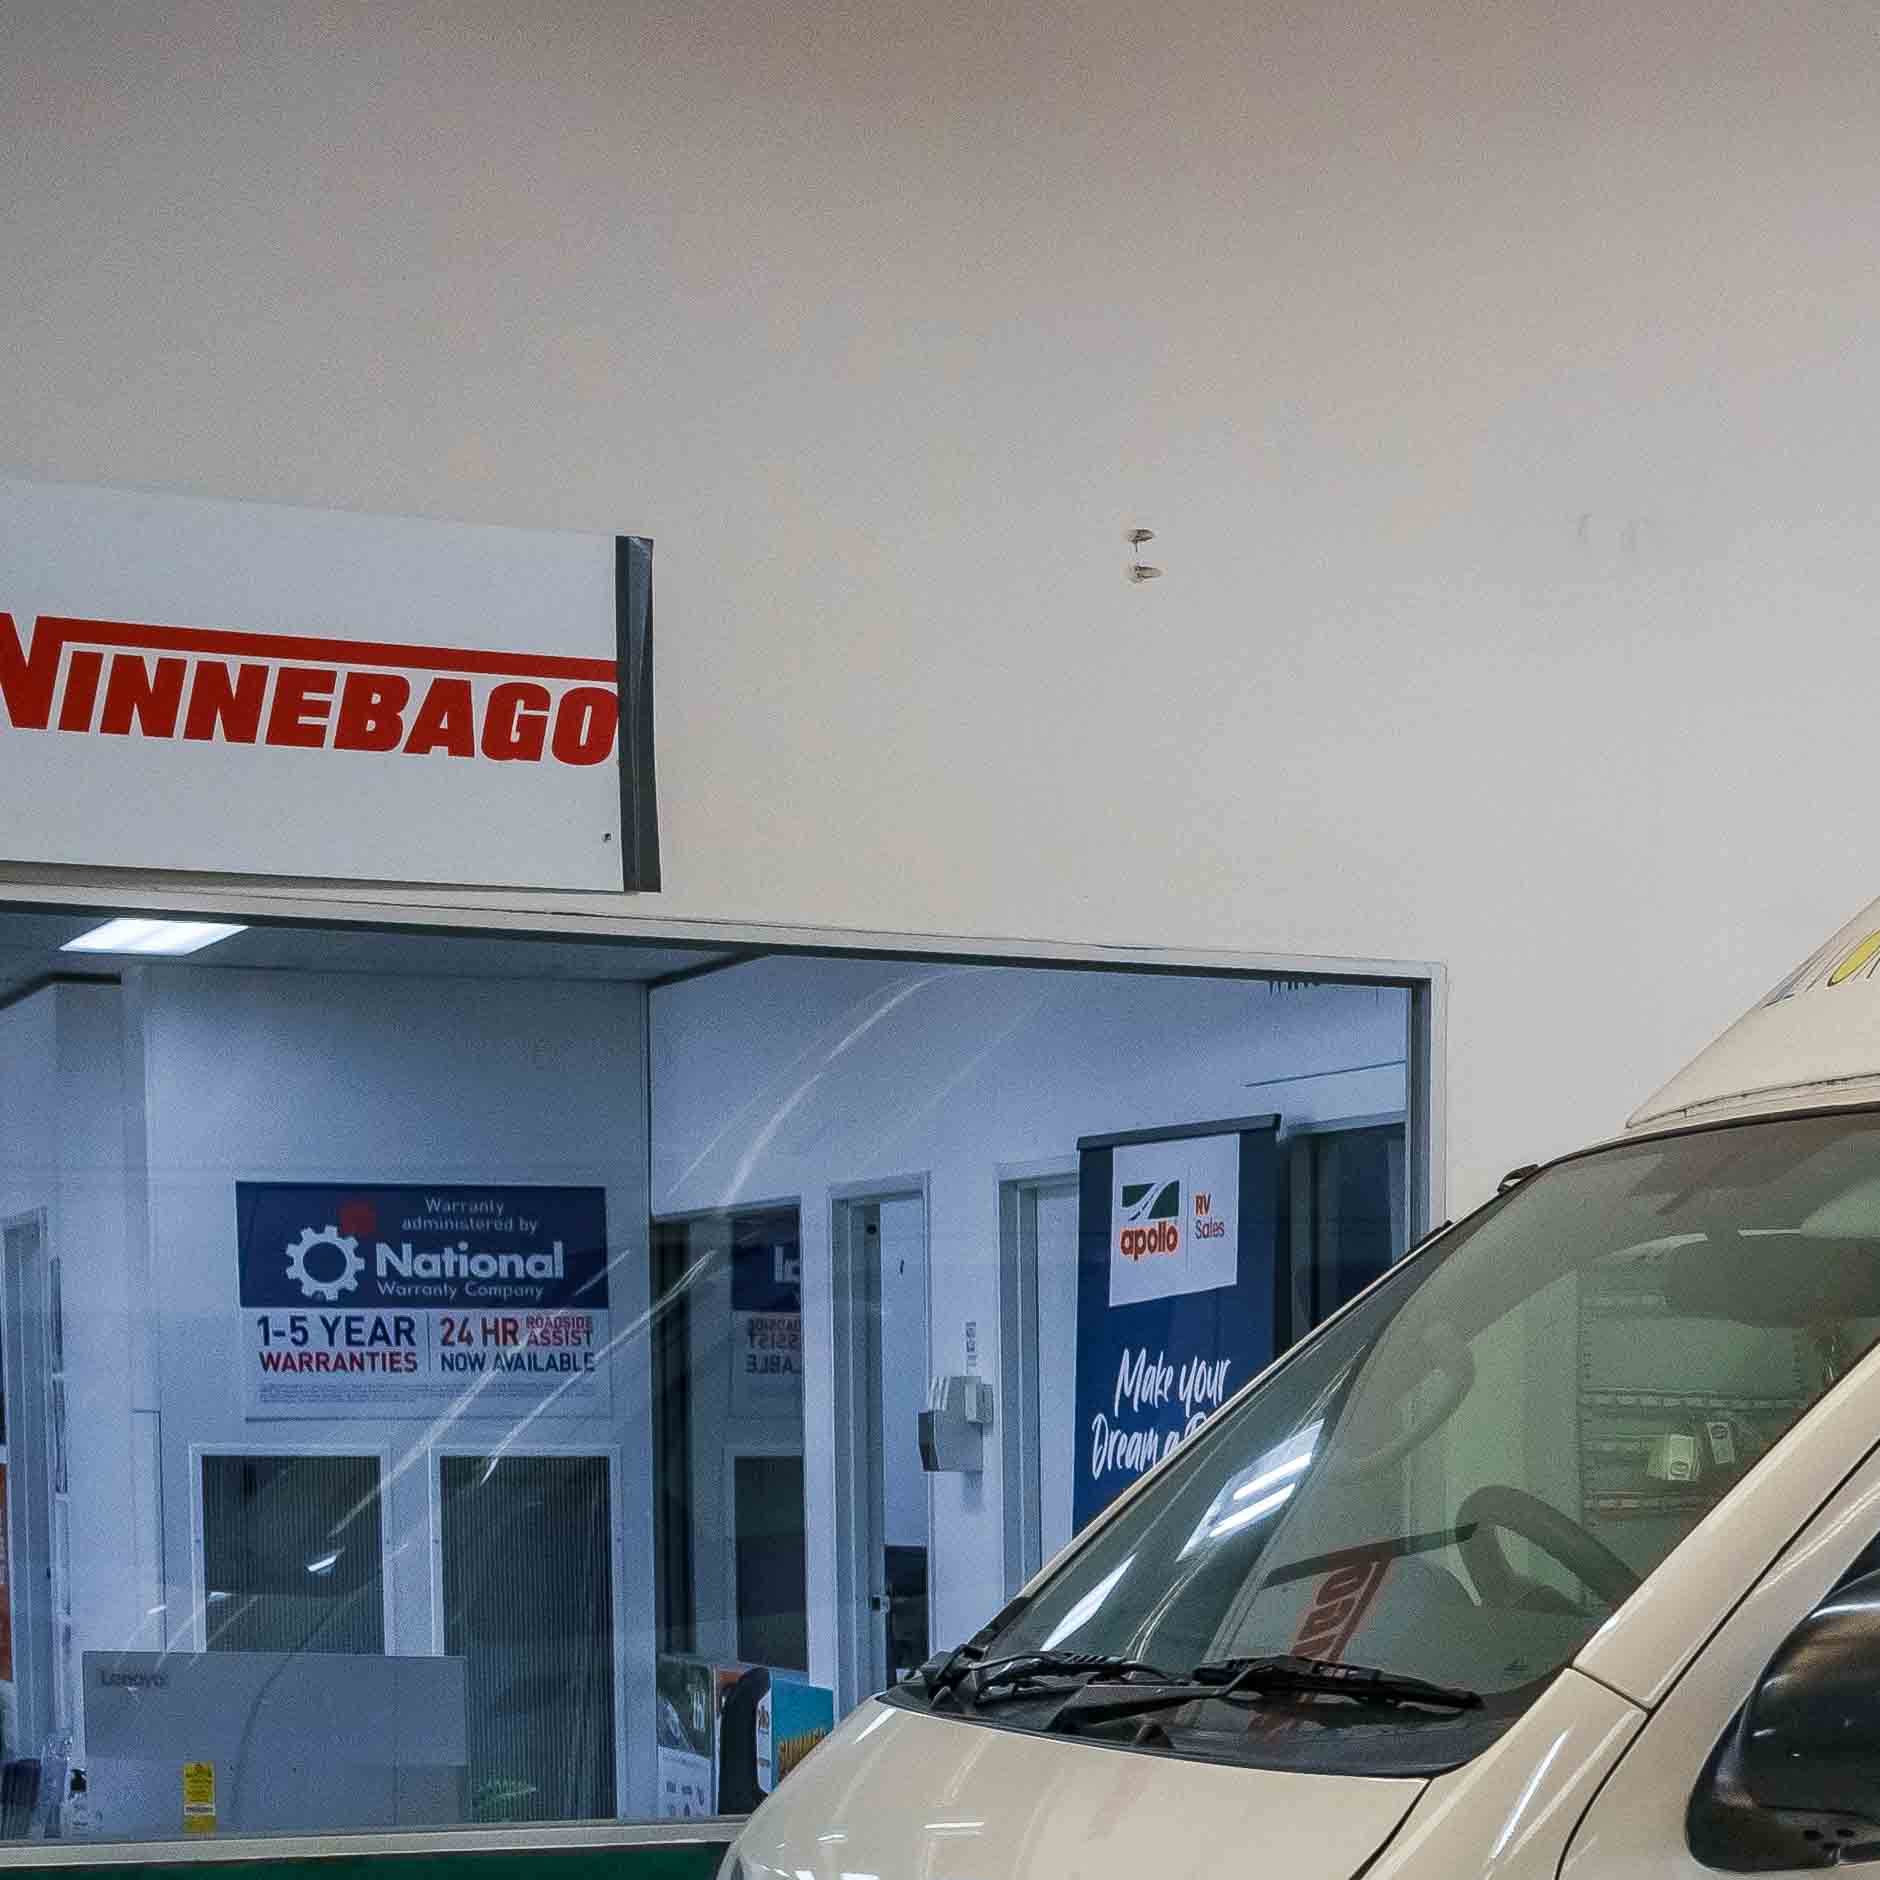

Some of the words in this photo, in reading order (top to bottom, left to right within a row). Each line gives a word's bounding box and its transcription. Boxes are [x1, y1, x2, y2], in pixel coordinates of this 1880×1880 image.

[424, 1197, 504, 1216] Warranty
[1195, 1193, 1211, 1216] RV
[401, 1216, 513, 1232] administered
[519, 1217, 537, 1235] by
[1195, 1218, 1225, 1240] Sales
[1120, 1221, 1179, 1261] apollo
[375, 1241, 564, 1278] National
[376, 1281, 457, 1298] Warranty
[464, 1281, 545, 1299] Company
[257, 1315, 309, 1347] 1-5
[320, 1315, 417, 1347] YEAR
[440, 1316, 474, 1347] 24
[480, 1316, 519, 1347] HR
[526, 1316, 593, 1329] ROADSIDE
[526, 1329, 592, 1346] ASSIST
[259, 1351, 418, 1373] WARRANTIES
[440, 1352, 486, 1372] NOW
[493, 1352, 595, 1373] AVAILABLE
[1114, 1347, 1174, 1417] Make
[1178, 1355, 1231, 1417] your
[1091, 1413, 1158, 1480] Dream
